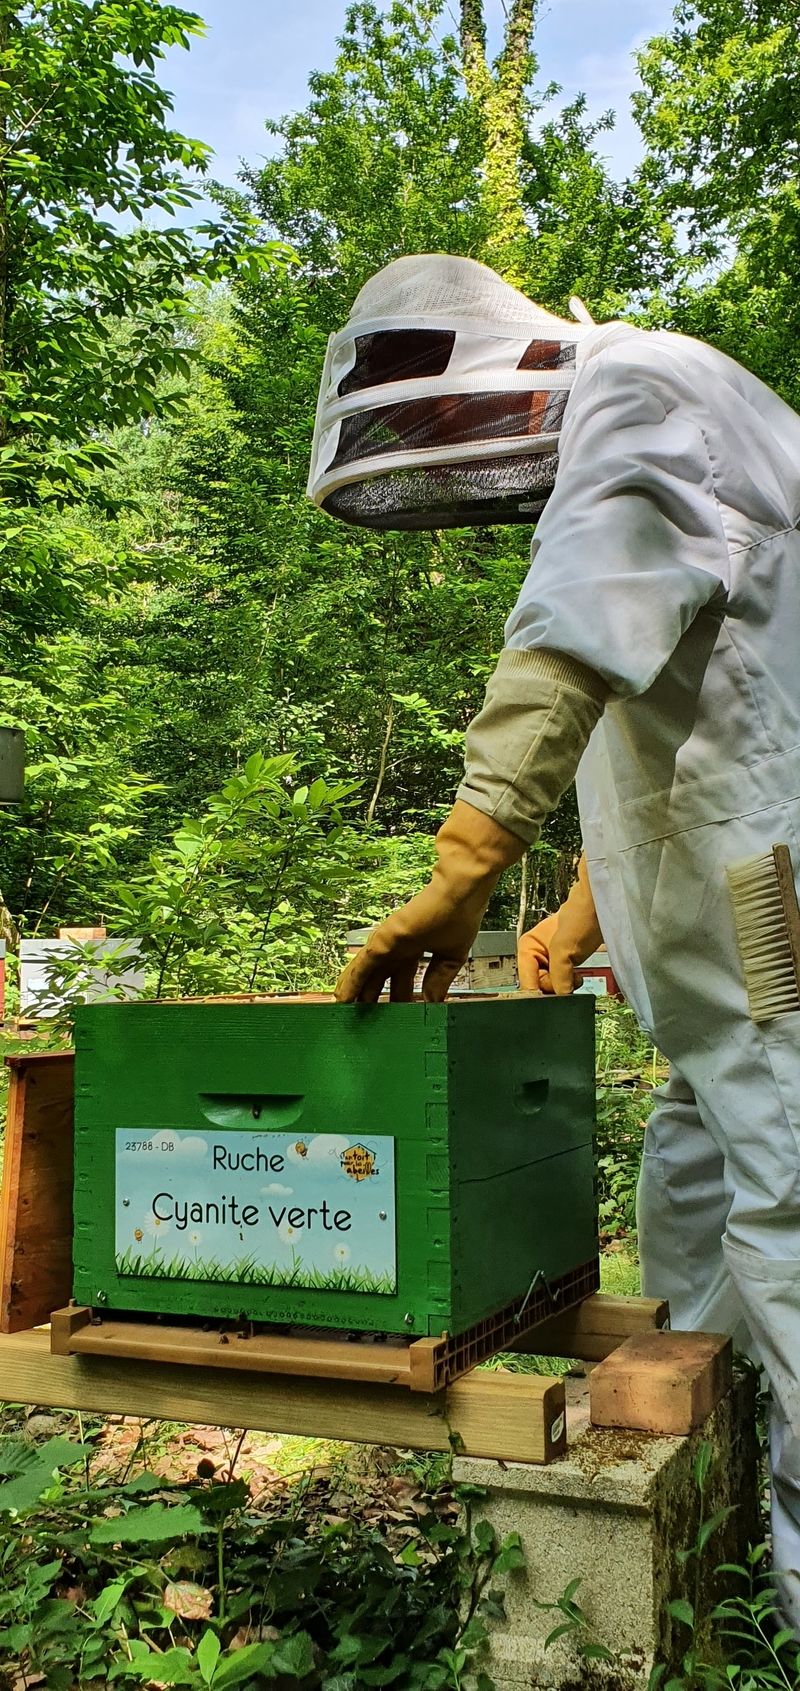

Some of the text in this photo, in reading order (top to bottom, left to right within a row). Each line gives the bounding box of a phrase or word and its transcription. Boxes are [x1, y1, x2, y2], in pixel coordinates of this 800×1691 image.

[125, 1141, 153, 1152] 23788
[161, 1141, 175, 1152] DB
[213, 1145, 285, 1173] Ruche
[353, 1150, 370, 1161] toit
[346, 1162, 380, 1175] abeilles
[152, 1192, 352, 1231] Cyanite verte
